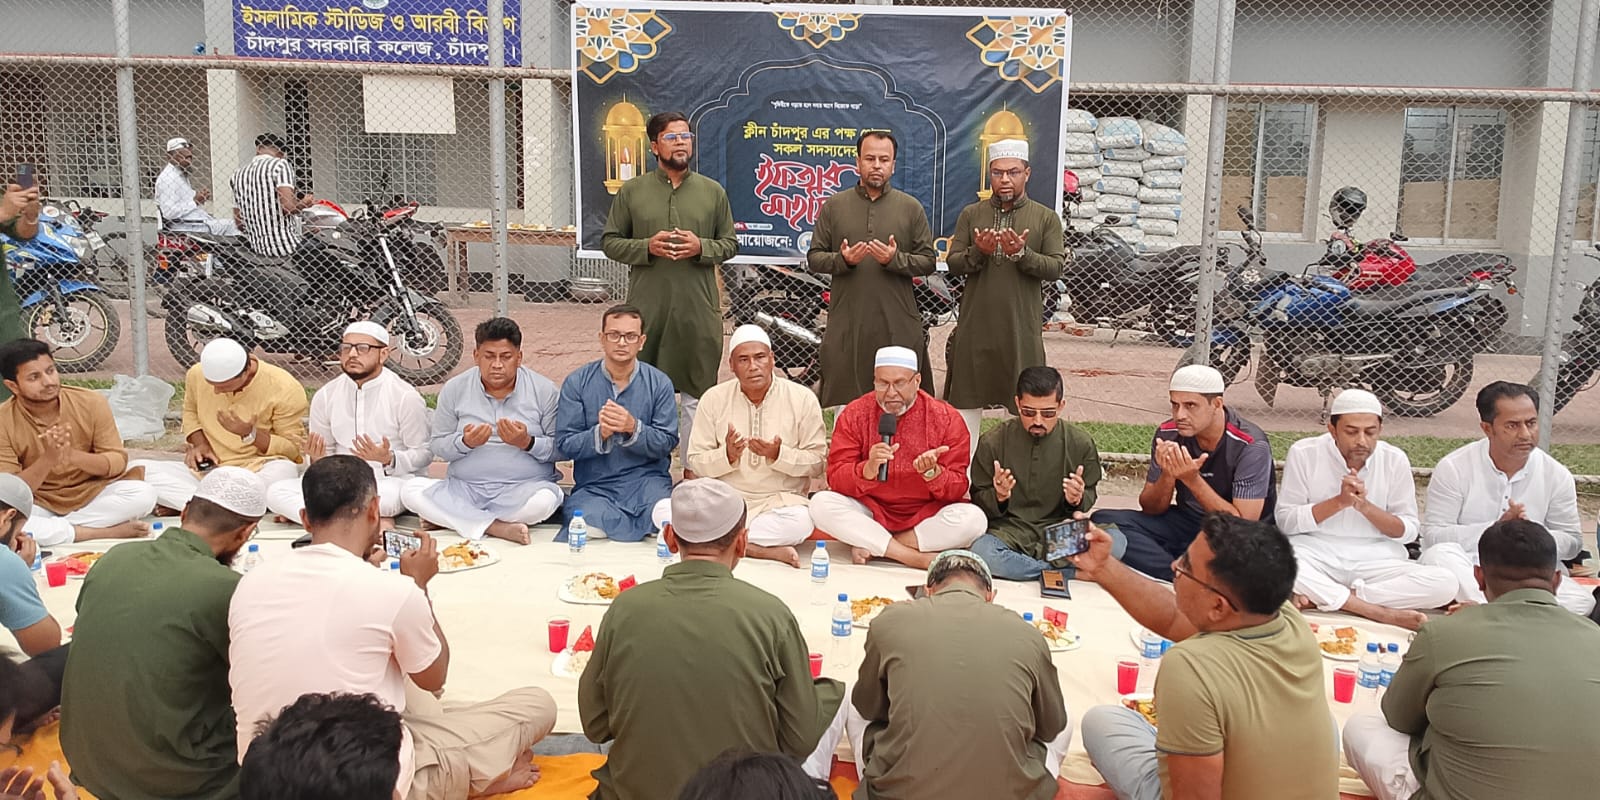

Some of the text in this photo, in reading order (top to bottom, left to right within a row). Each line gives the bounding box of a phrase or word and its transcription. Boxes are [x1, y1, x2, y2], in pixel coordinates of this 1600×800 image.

[240, 7, 318, 31] ইসলামিক
[323, 7, 385, 32] স্টাডিজ
[390, 15, 405, 31] ও
[410, 8, 462, 35] আরবী
[245, 31, 302, 55] চাঁদপুর
[307, 34, 373, 56] সরকারি
[377, 39, 441, 60] কলেজ,
[743, 121, 768, 139] ক্লীন
[770, 122, 809, 142] চাঁদপুর
[811, 127, 831, 140] এর
[834, 127, 857, 140] পক্ষ
[772, 143, 858, 158] সকল সদস্যদের
[754, 153, 861, 200] ইফতার
